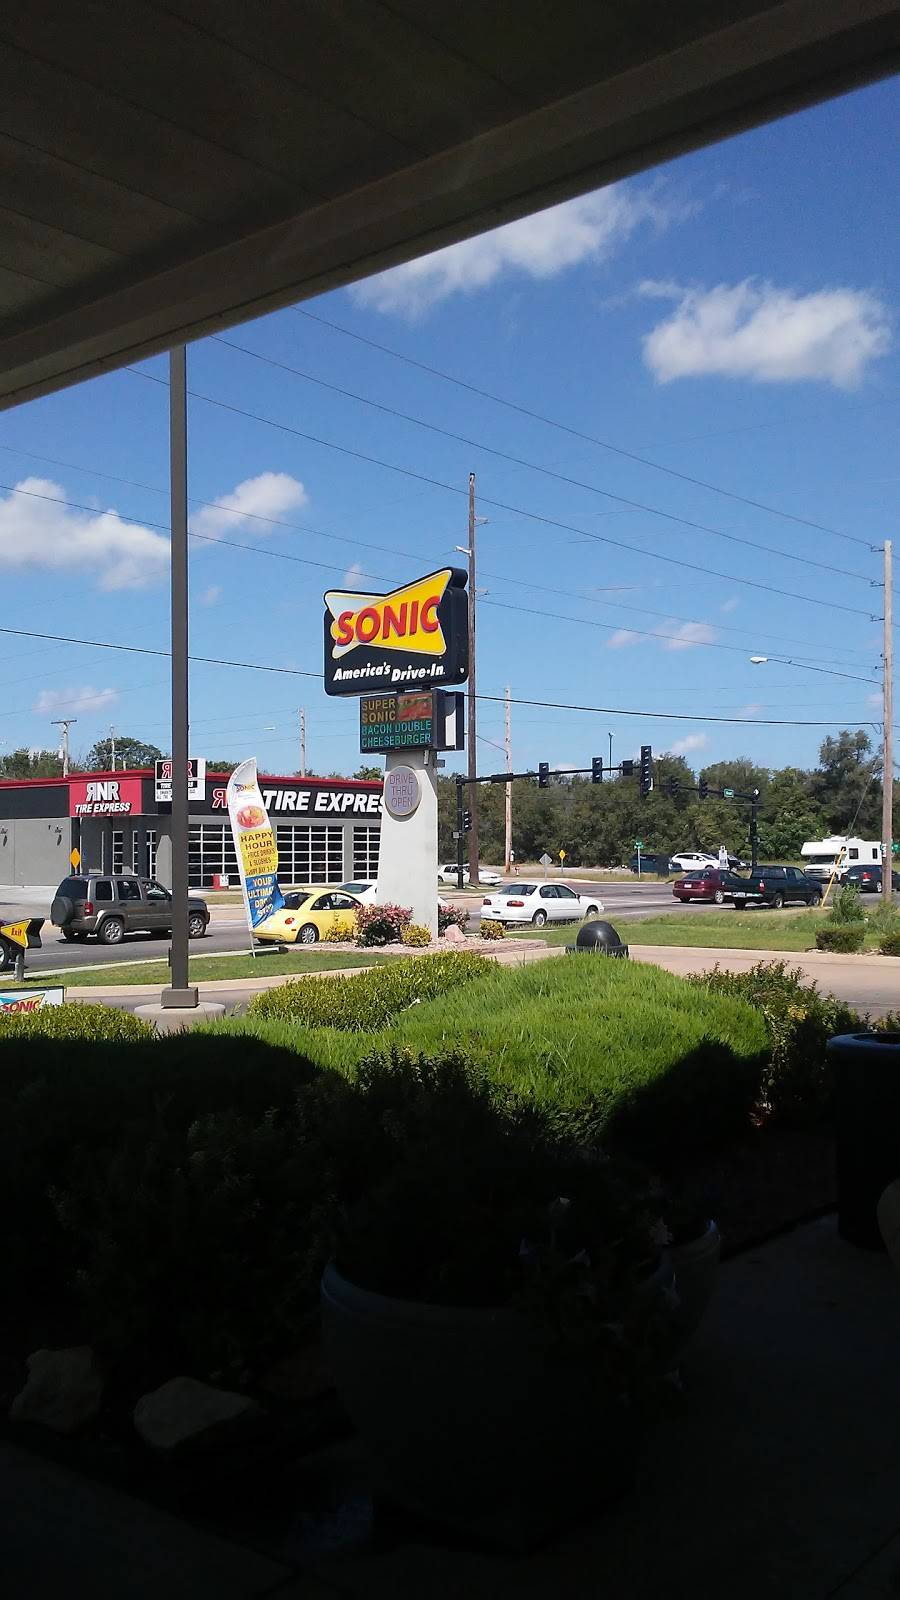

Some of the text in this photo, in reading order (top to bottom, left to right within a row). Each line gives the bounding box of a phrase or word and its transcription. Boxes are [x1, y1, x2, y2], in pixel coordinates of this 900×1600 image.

[336, 595, 441, 647] SONIC
[333, 661, 391, 681] America's
[361, 698, 396, 711] SUPER
[361, 711, 396, 723] SONIC
[361, 720, 432, 735] BACON DOUBLE
[361, 733, 431, 748] CHEESEBURGER
[389, 773, 414, 785] DRIVE
[391, 785, 413, 796] THRU
[262, 790, 311, 811] TIRE
[391, 797, 413, 808] OPEN
[75, 802, 131, 814] TIRE EXPRESS
[240, 831, 273, 843] HAPPY
[245, 840, 273, 850] HOUR
[11, 928, 22, 937] Exit
[2, 1000, 39, 1012] SONIC
